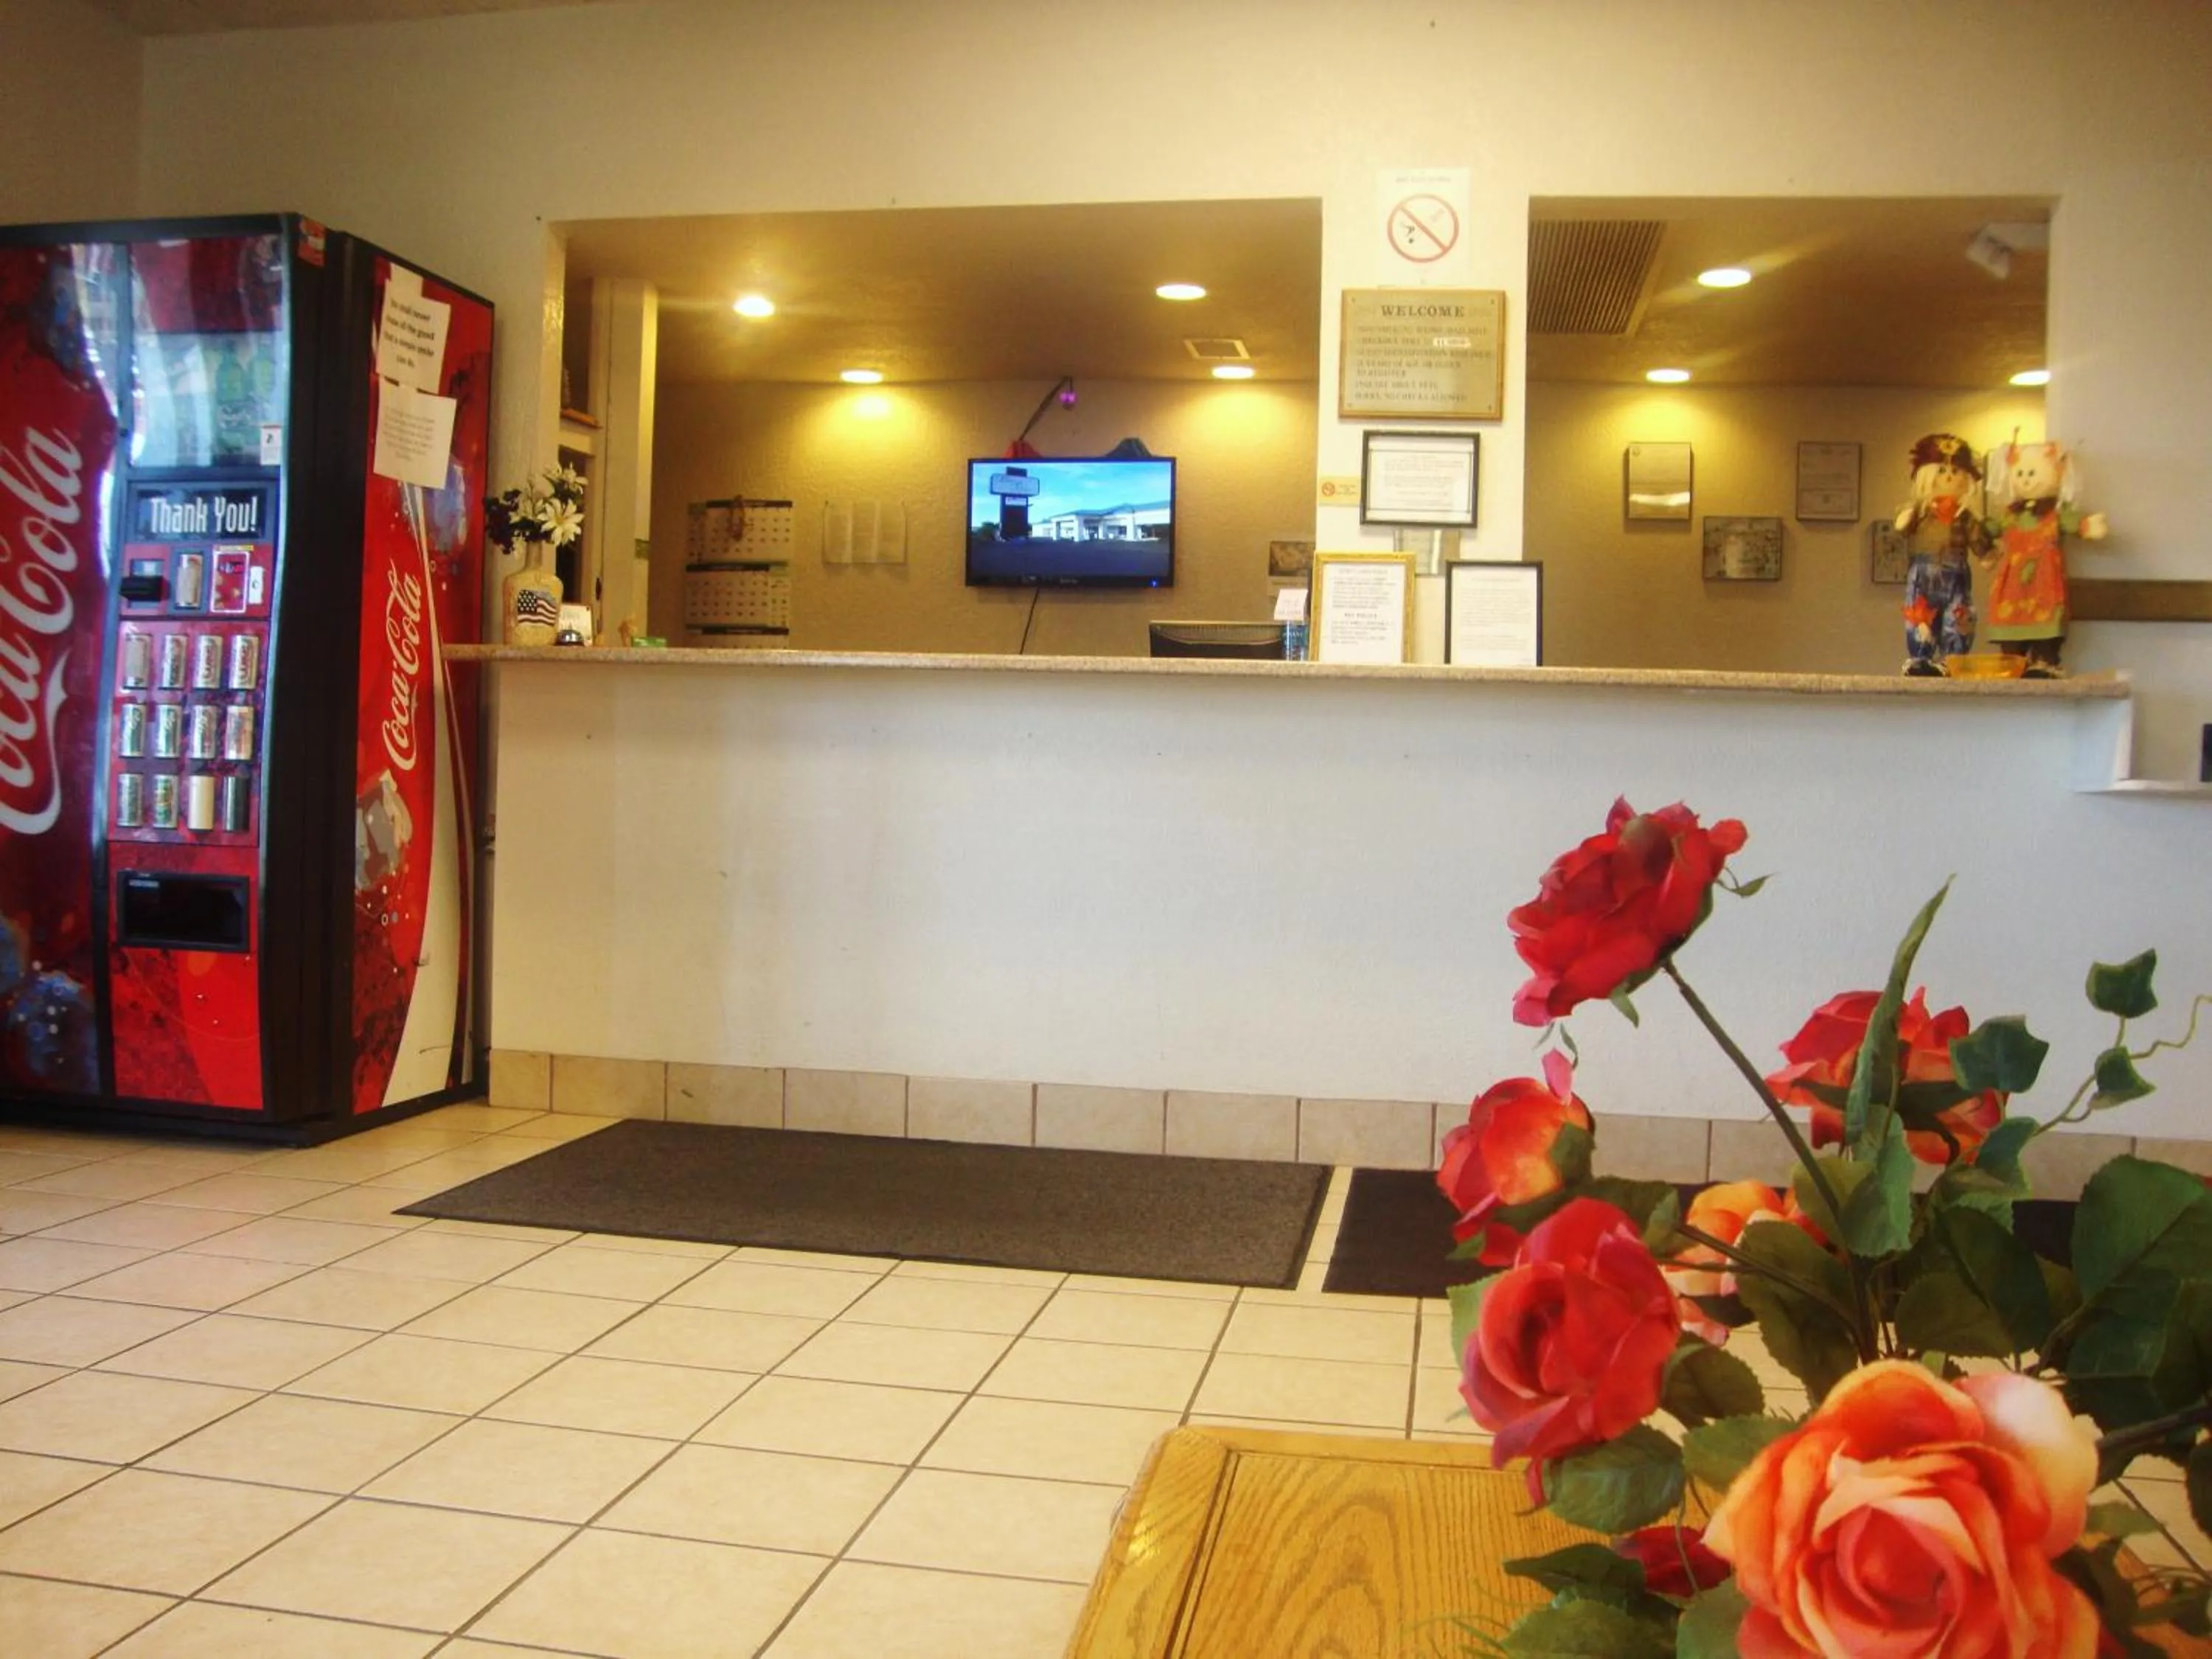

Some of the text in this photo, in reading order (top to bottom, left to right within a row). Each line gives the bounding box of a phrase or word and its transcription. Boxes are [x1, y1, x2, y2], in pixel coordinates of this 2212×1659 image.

[1382, 305, 1465, 318] WELCOME
[150, 495, 258, 534] Thank You!
[0, 426, 83, 835] ocaCola
[383, 558, 421, 771] Coca-Cola
